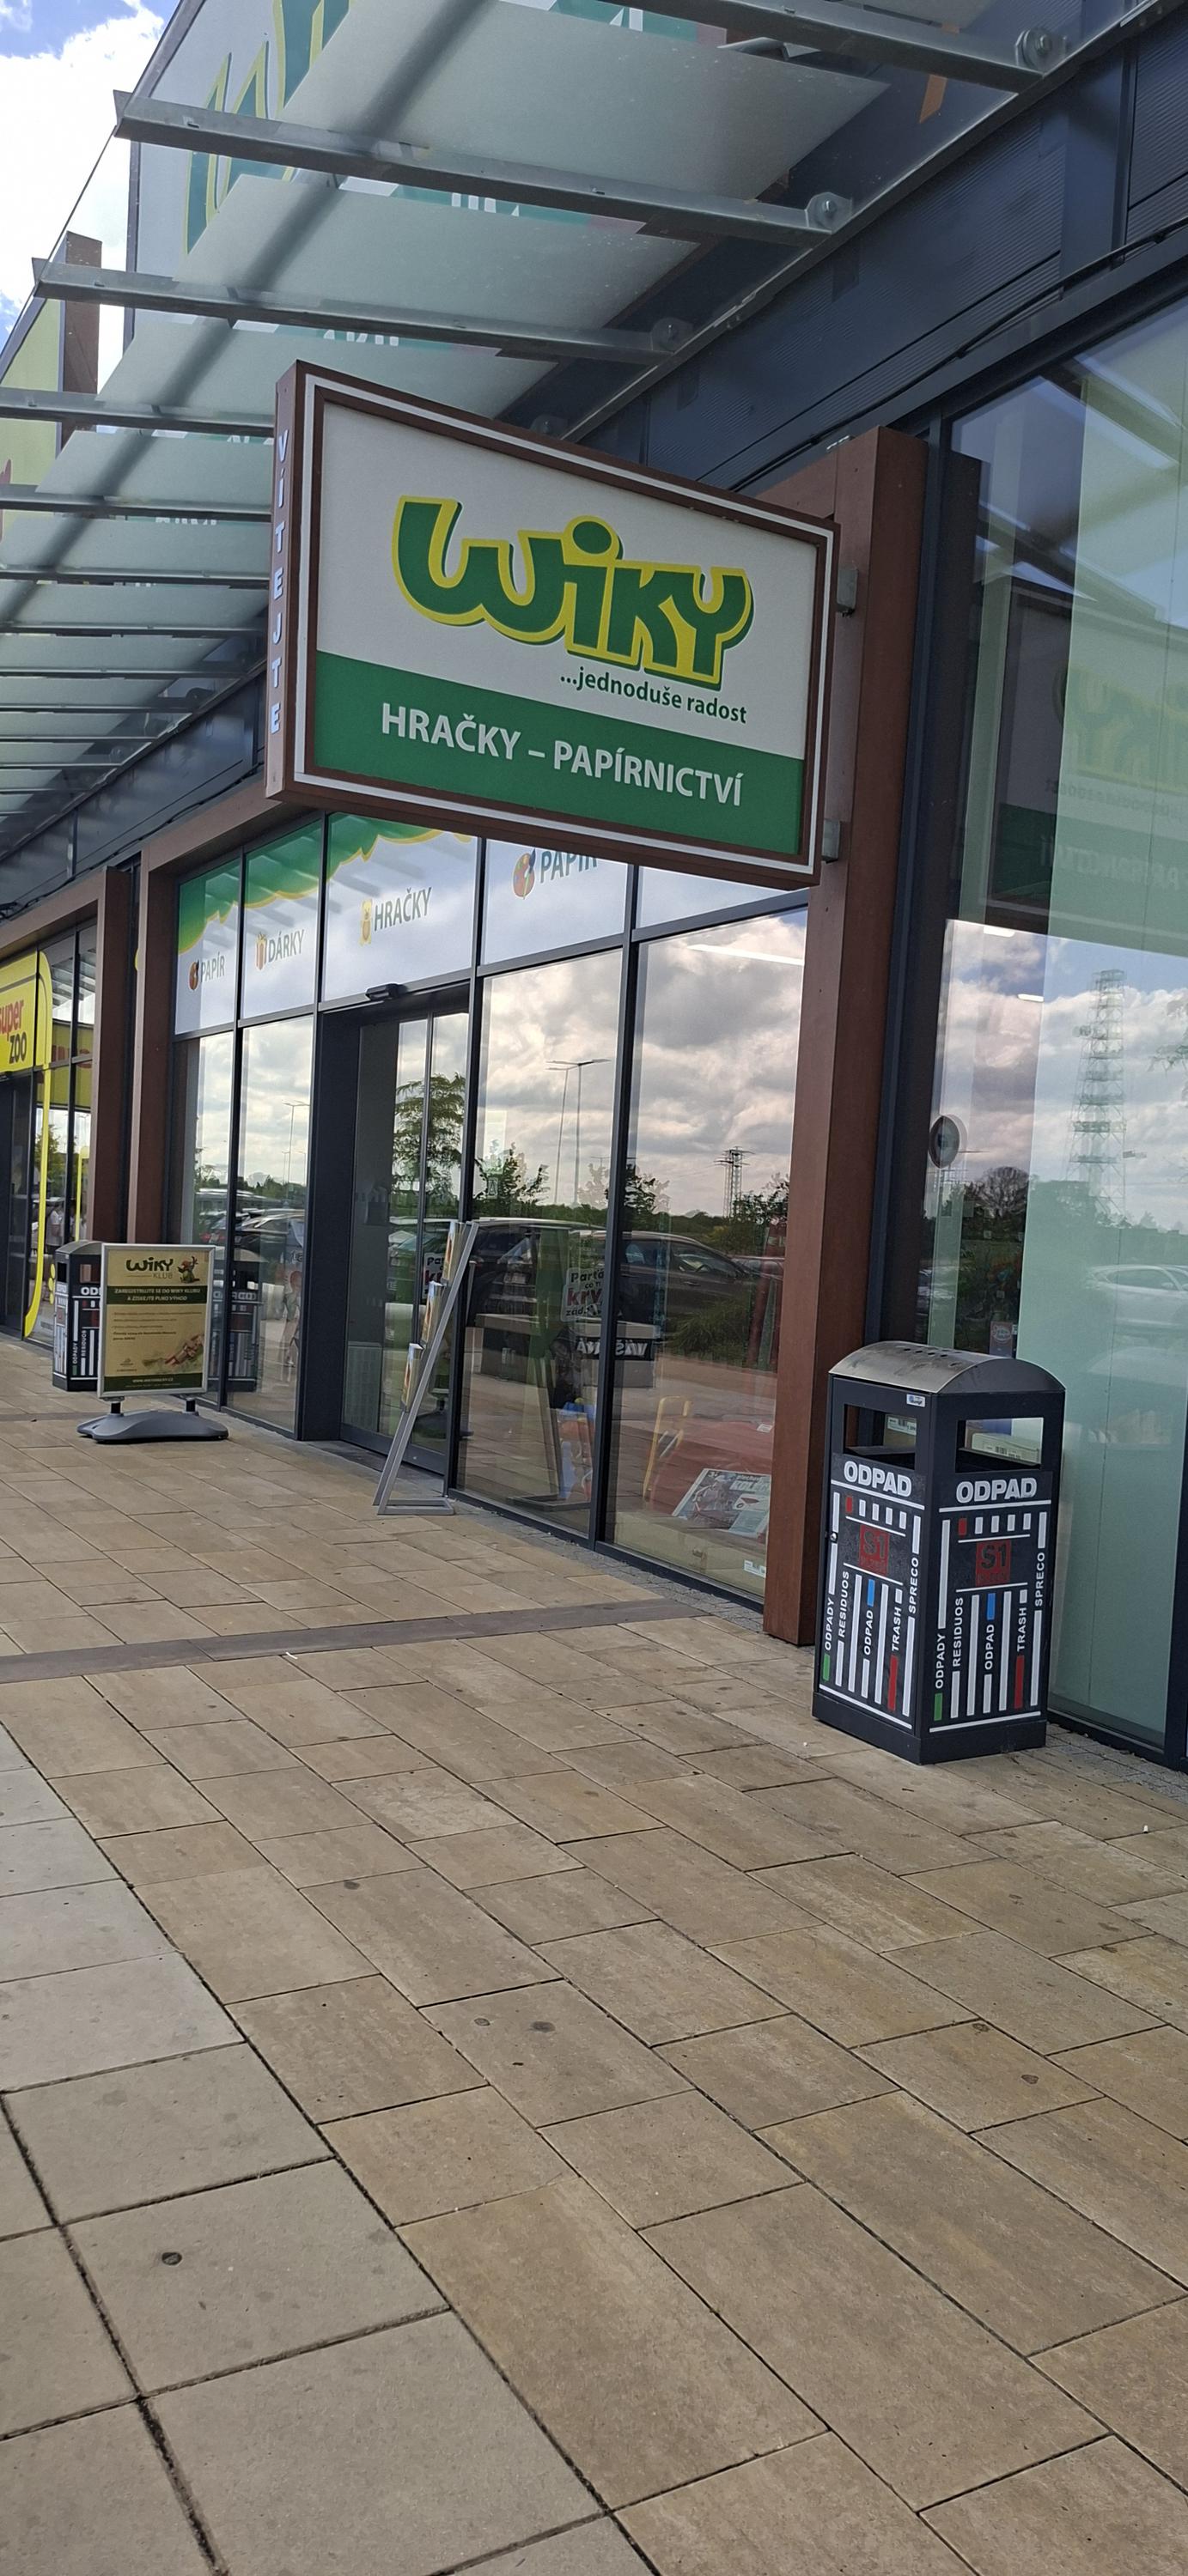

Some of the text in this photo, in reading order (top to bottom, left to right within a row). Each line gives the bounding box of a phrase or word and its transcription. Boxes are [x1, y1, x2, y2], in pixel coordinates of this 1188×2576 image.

[270, 430, 289, 733] VÍTEJTE
[560, 666, 746, 723] ...jednoduše radost
[381, 702, 521, 760] HRAČKY
[554, 740, 744, 806] PAPÍRNICTVÍ
[540, 851, 597, 884] PAP
[375, 887, 432, 932] HRAČKY
[200, 951, 225, 982] PAPÍR
[268, 929, 305, 963] DÁRKY
[844, 1461, 912, 1498] ODPAD
[956, 1477, 1038, 1504] ODPAD
[909, 1557, 919, 1614] SPRECO
[1035, 1552, 1045, 1607] SPRECO
[825, 1597, 834, 1650] ODPADY
[838, 1571, 849, 1638] RESIDUOS
[863, 1610, 873, 1656] ODPAD
[892, 1607, 902, 1651] TRASH
[953, 1597, 964, 1667] RESIDUOS
[984, 1624, 995, 1670] ODPAD
[1017, 1607, 1027, 1652] TRASH
[935, 1633, 945, 1689] ODPADY
